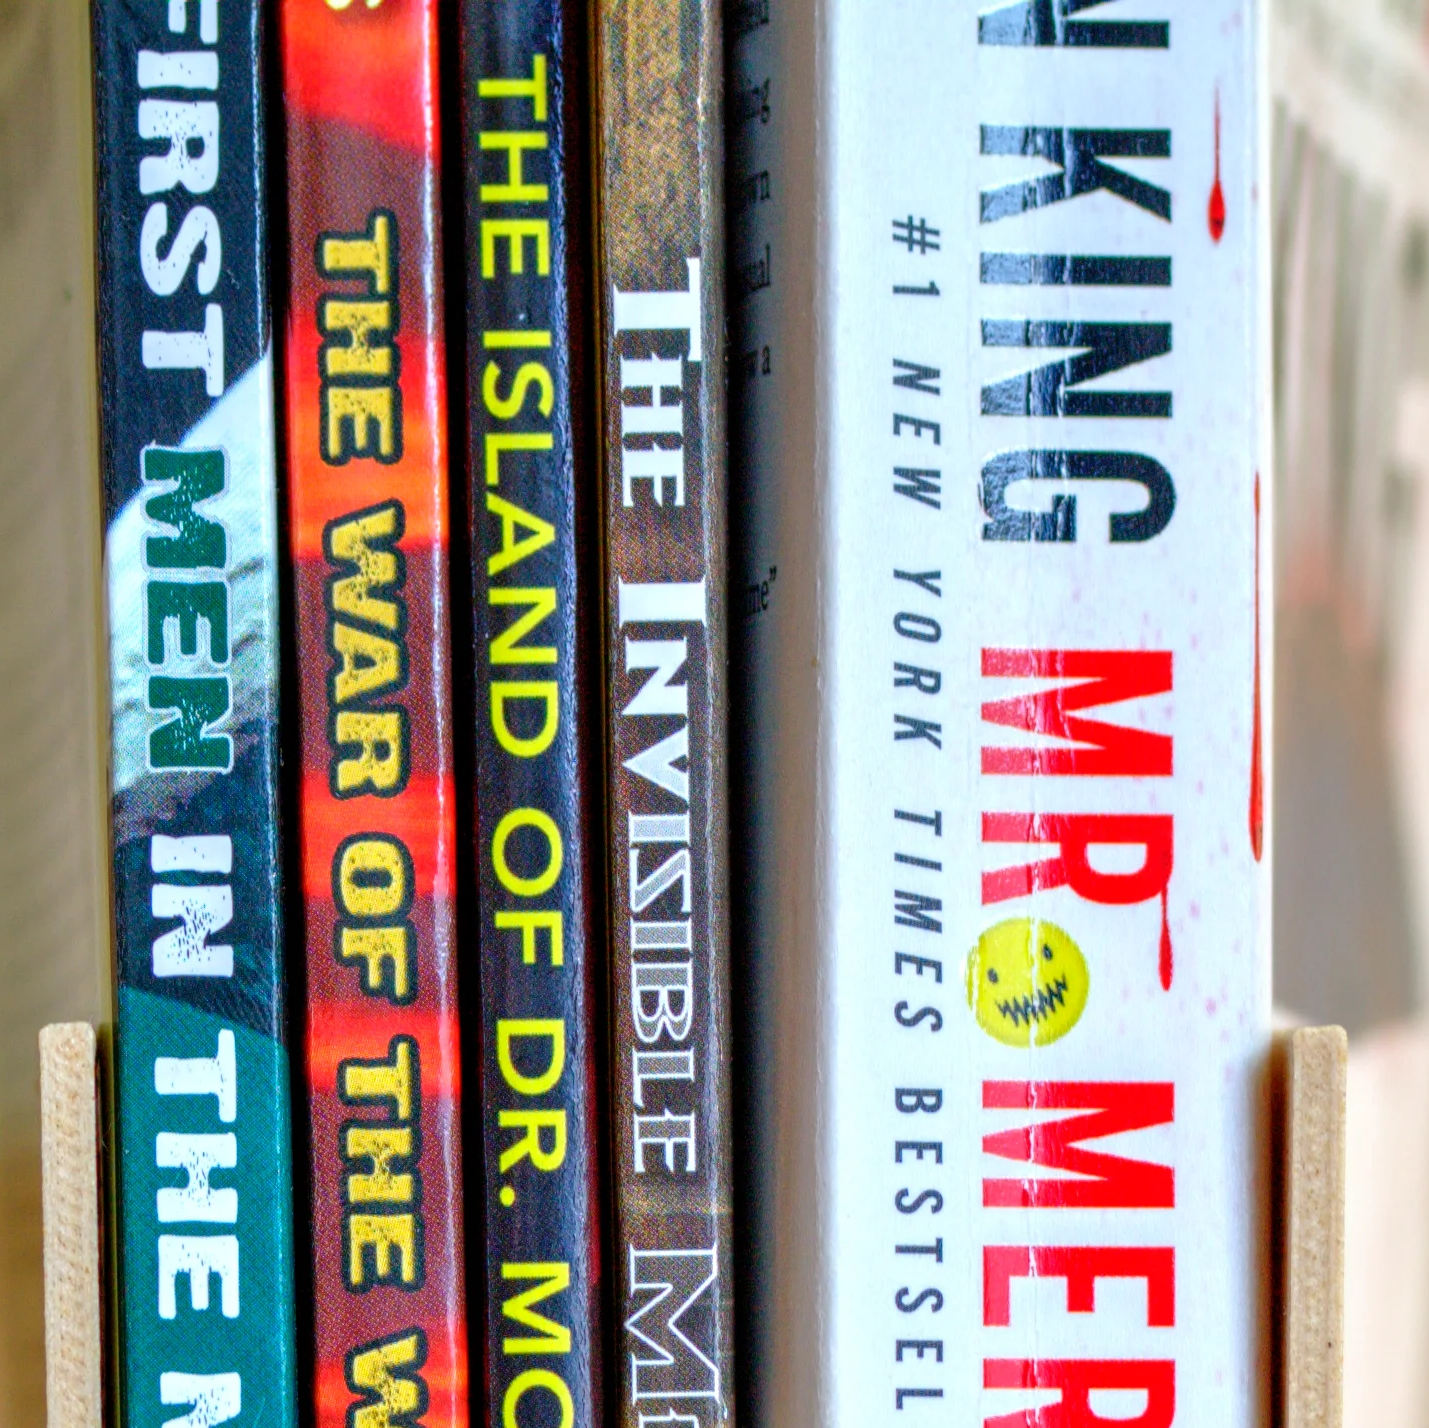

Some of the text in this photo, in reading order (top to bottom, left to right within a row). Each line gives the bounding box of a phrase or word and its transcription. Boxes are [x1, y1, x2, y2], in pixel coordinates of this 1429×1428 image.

[478, 54, 550, 278] THE
[891, 214, 941, 297] #1
[320, 212, 398, 463] THE
[613, 257, 701, 507] THE
[892, 358, 941, 510] NEW
[978, 124, 1176, 543] KING
[141, 444, 234, 774] MEN
[327, 503, 407, 795] WAR
[483, 330, 558, 757] ISLAND
[893, 569, 942, 749] YORK
[491, 807, 564, 966] OF
[618, 575, 707, 1173] INVISIBLE
[981, 647, 1174, 906] MR
[150, 834, 234, 977] IN
[336, 837, 413, 1002] OF
[894, 809, 943, 1033] TIMES
[154, 1029, 239, 1319] THE
[341, 1037, 420, 1290] THE
[496, 1019, 568, 1207] DR.
